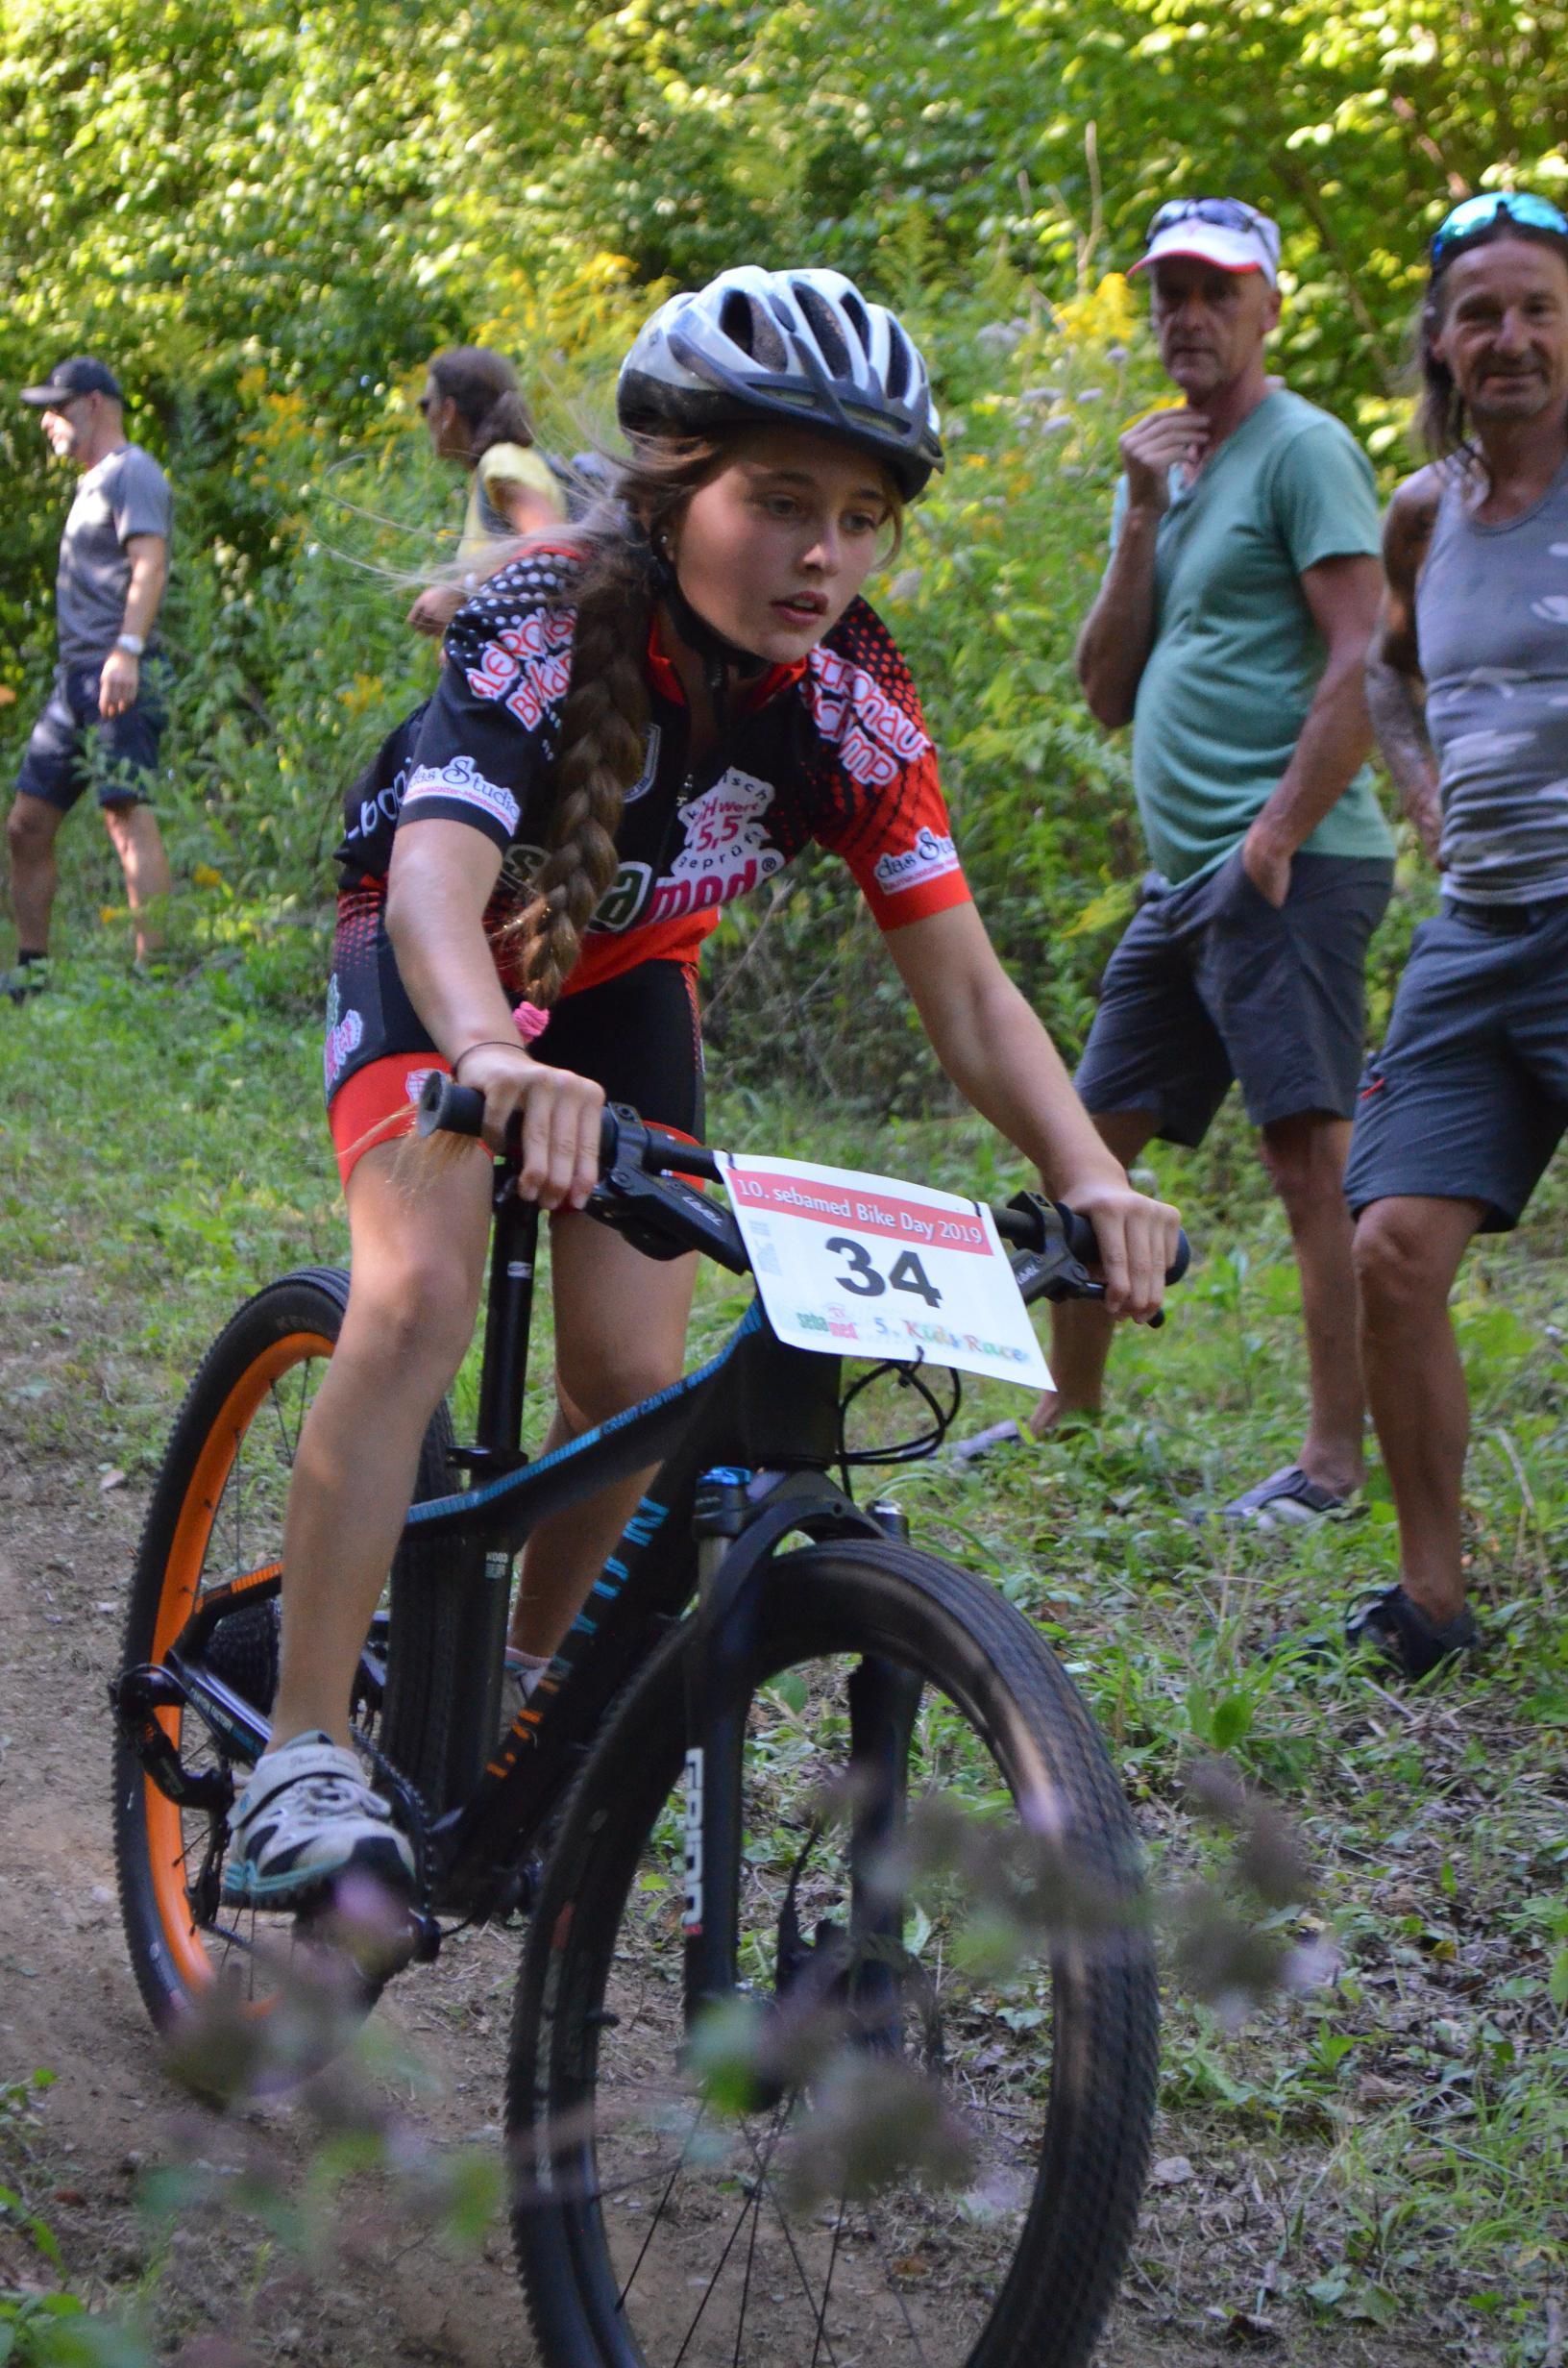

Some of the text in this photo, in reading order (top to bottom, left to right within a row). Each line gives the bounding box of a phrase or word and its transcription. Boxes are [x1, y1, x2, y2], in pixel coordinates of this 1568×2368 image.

[442, 759, 519, 820] Studio
[738, 1178, 983, 1246] 10. sebamed Bike Day 2019
[825, 1236, 944, 1310] 34
[874, 1317, 900, 1340] 5.
[962, 1333, 1028, 1363] Race
